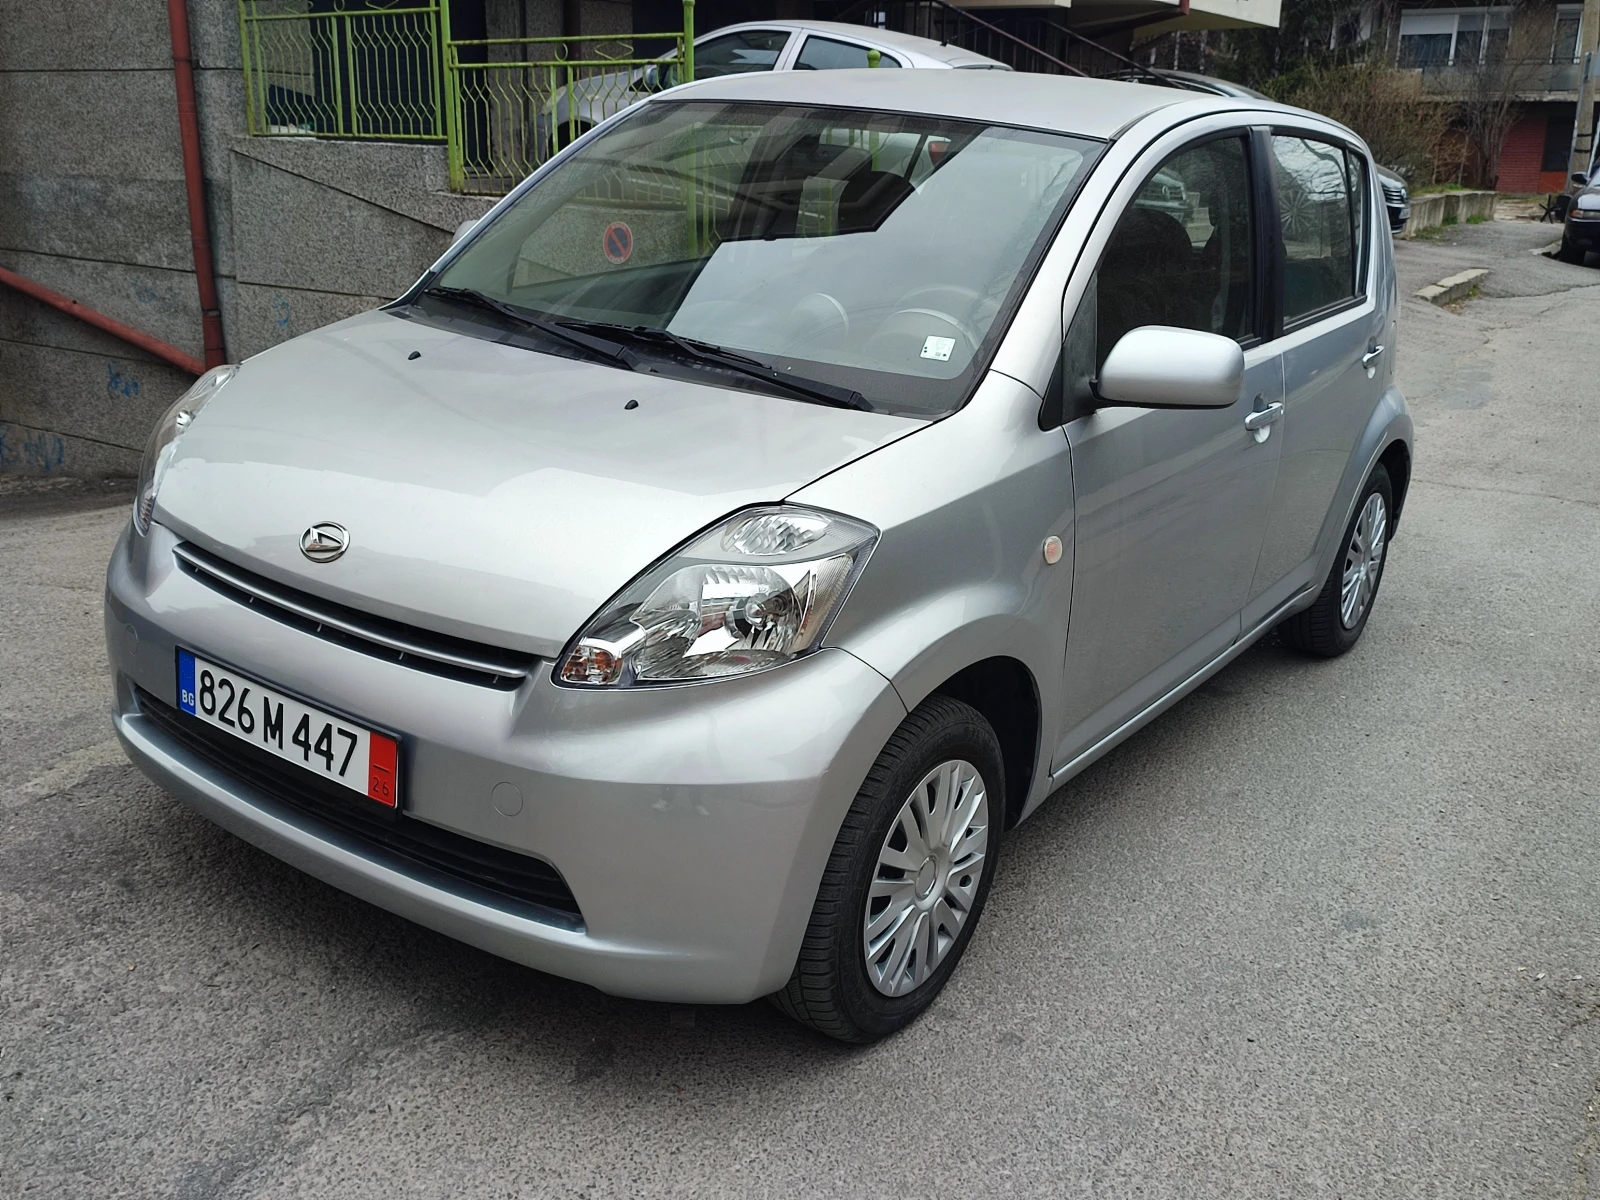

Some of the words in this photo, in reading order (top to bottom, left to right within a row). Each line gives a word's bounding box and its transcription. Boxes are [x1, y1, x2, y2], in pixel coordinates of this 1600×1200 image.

[181, 689, 195, 707] BG
[199, 669, 255, 734] 826
[263, 696, 284, 750] M
[292, 713, 358, 777] 447
[372, 777, 390, 796] 26
